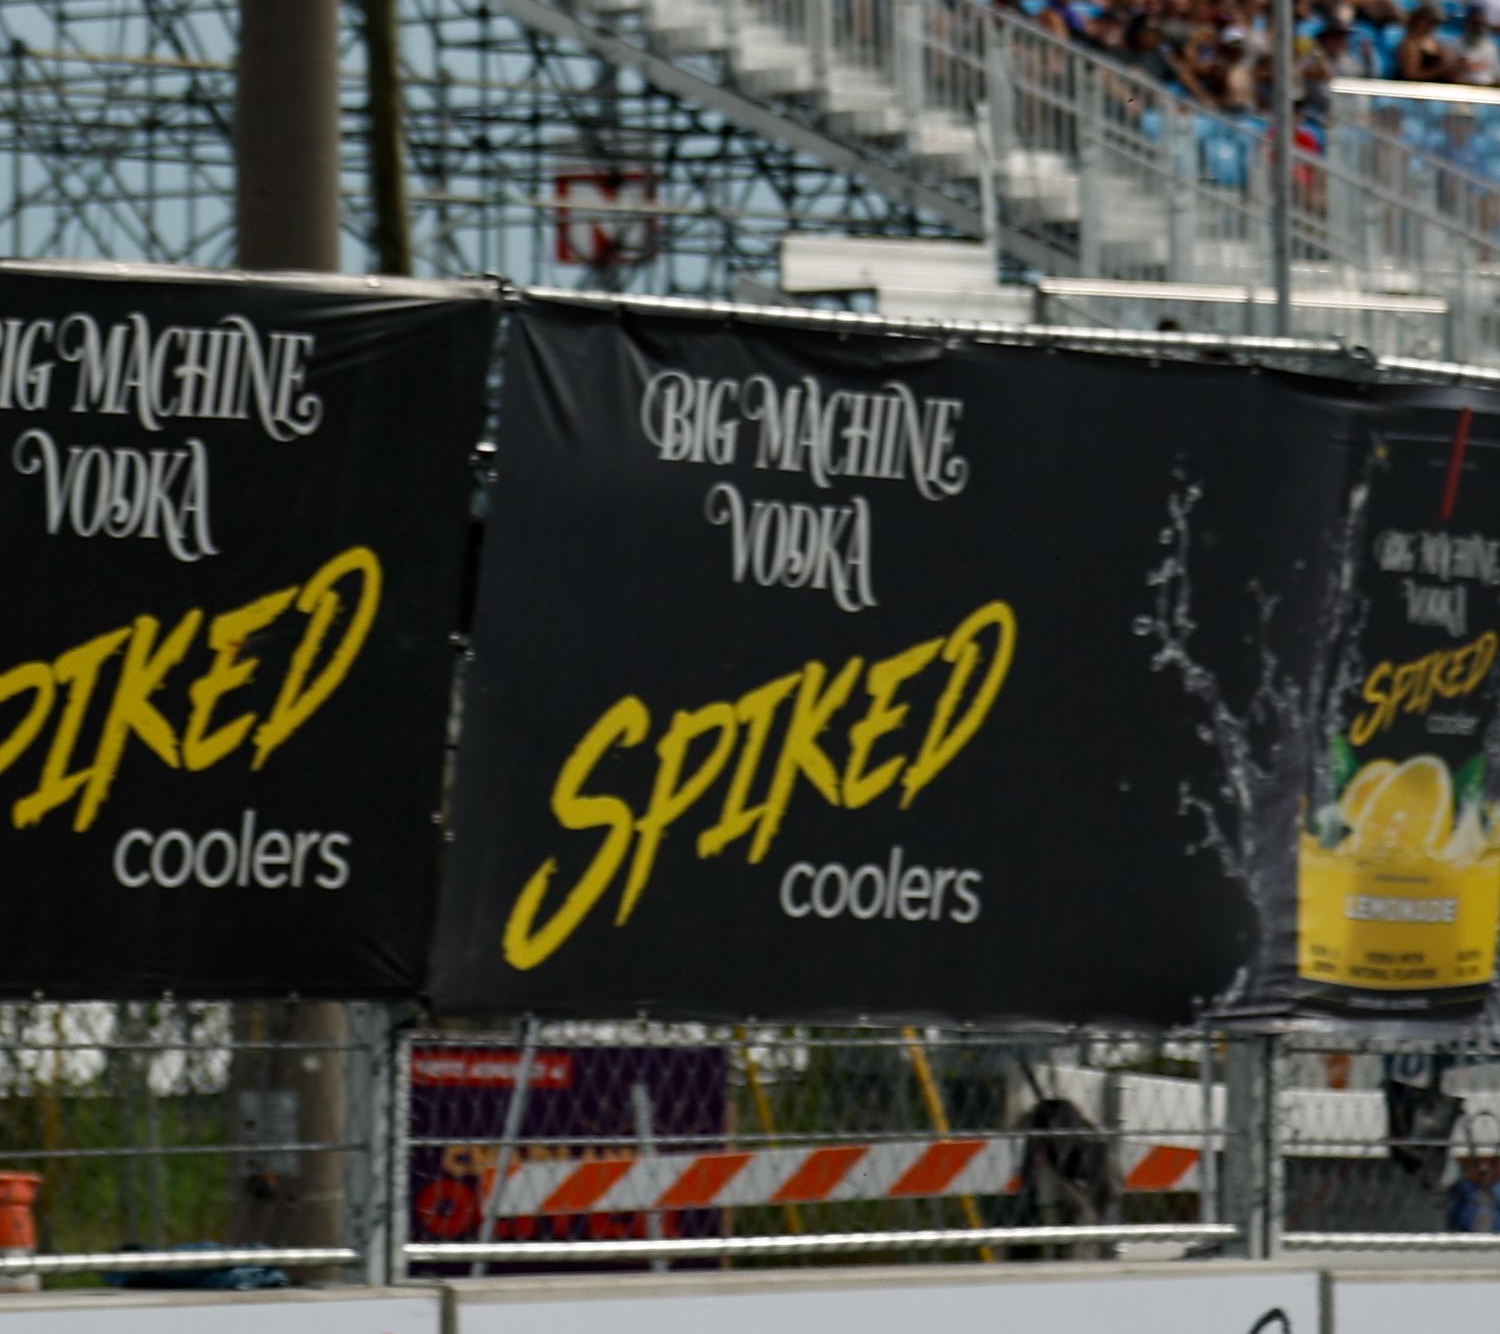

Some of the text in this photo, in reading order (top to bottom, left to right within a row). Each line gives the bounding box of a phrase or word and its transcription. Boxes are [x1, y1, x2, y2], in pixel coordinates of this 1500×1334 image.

[57, 312, 323, 442] MACHINE
[641, 369, 970, 499] BIG MACHINE
[12, 427, 220, 563] VODKA
[704, 483, 877, 610] VODKA
[1349, 630, 1498, 748] SPIKED
[113, 809, 352, 889] coolers
[501, 601, 1016, 971] SPIKED
[779, 844, 981, 923] coolers
